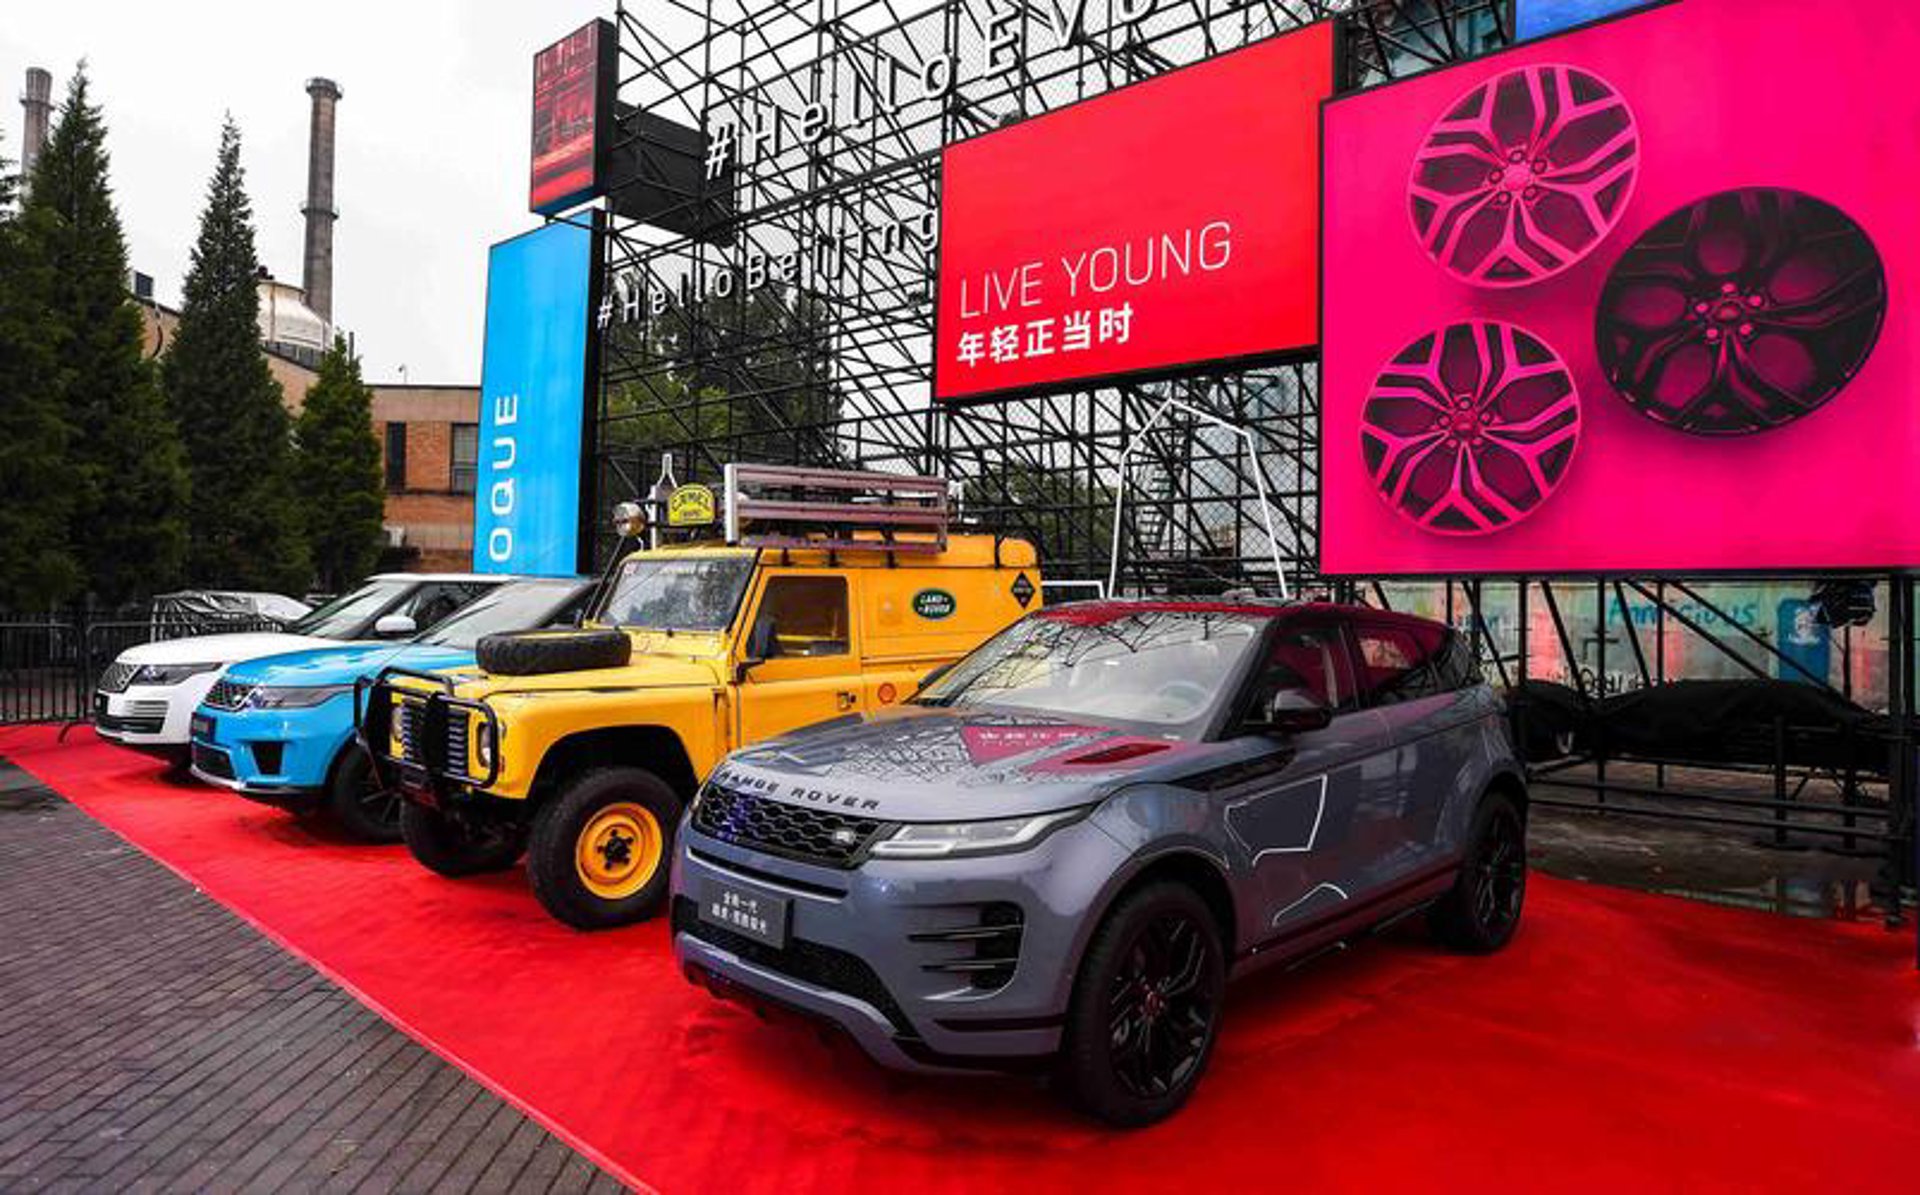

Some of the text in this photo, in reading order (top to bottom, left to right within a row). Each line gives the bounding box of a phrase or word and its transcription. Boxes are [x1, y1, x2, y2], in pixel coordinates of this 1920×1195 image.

[598, 210, 938, 328] #HelloBeijing
[960, 221, 1231, 318] LIVE YOUNG
[956, 302, 1134, 367] 年轻正当时
[790, 787, 880, 811] ROVER
